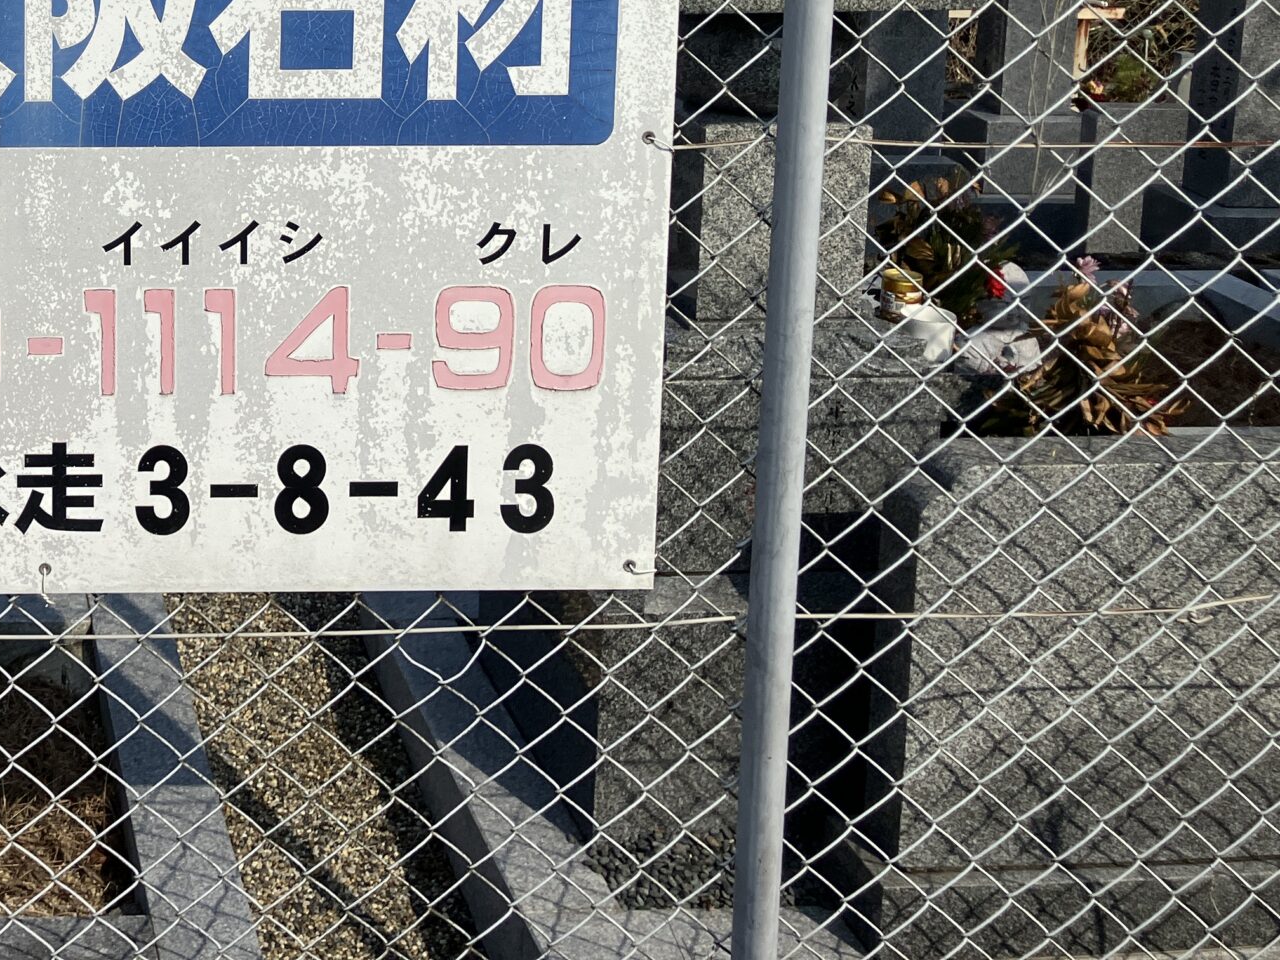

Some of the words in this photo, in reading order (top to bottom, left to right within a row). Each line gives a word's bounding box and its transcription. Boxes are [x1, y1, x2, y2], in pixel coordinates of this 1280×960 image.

[101, 220, 324, 266] イイイシ
[475, 221, 583, 266] クレ
